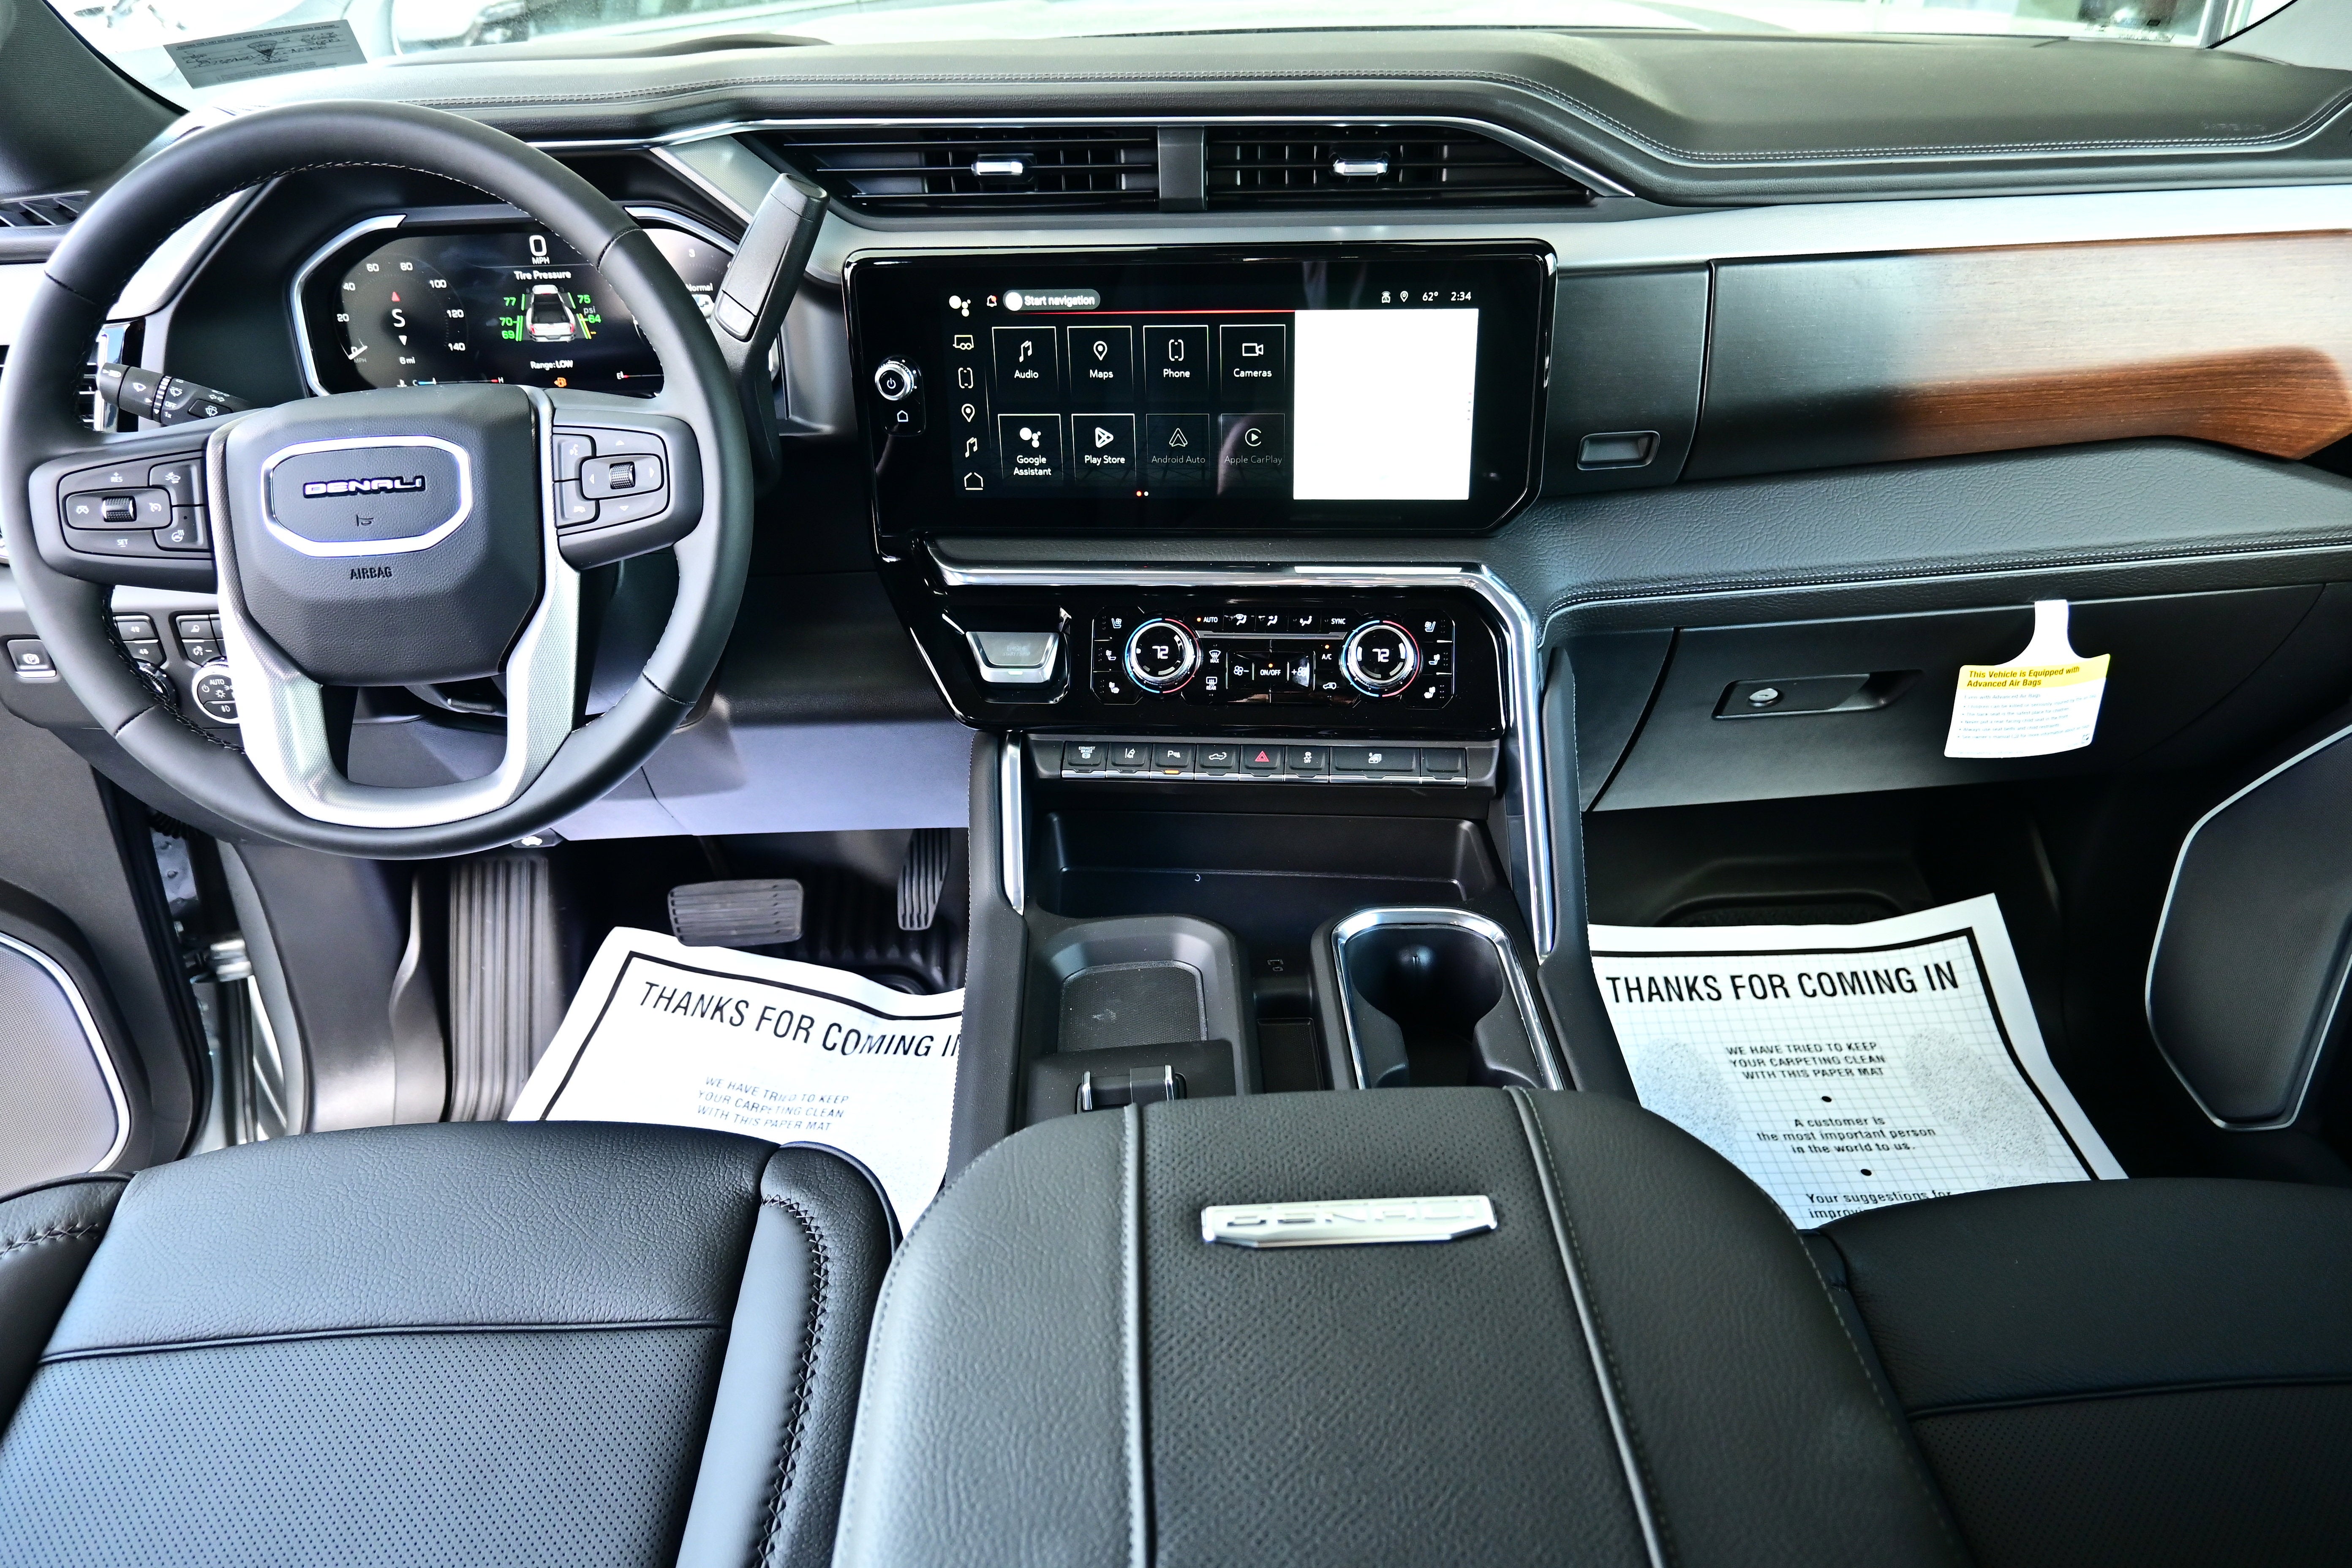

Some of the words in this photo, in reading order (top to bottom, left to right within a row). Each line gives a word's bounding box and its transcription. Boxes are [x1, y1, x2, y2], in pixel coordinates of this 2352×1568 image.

[529, 235, 547, 256] 0
[367, 264, 379, 272] 60
[400, 262, 413, 271] 80
[514, 271, 532, 280] Tire
[533, 270, 571, 280] Pressure
[343, 282, 356, 291] 40
[429, 280, 447, 288] 100
[685, 283, 713, 291] Normal
[504, 297, 516, 306] 77
[577, 295, 591, 304] 75
[1024, 295, 1047, 306] Start
[1048, 296, 1095, 307] navigation
[1451, 291, 1471, 301] 2:34
[446, 309, 464, 318] 120
[583, 306, 596, 315] psi
[337, 313, 349, 322] 20
[392, 309, 406, 327] S
[499, 317, 513, 326] 70
[588, 314, 602, 324] 64
[501, 330, 514, 339] 69
[448, 343, 466, 351] 140
[1014, 370, 1039, 379] Audio
[1089, 369, 1113, 380] Maps
[1163, 368, 1190, 378] Phone
[1233, 368, 1272, 378] Cameras
[1016, 455, 1047, 466] Google
[1085, 455, 1102, 466] Play
[1103, 455, 1125, 464] Store
[1152, 455, 1184, 463] Android
[1186, 455, 1206, 463] Auto
[1225, 455, 1248, 466] Apple
[1251, 455, 1282, 466] CarPlay
[1013, 467, 1052, 476] Assistant
[303, 475, 425, 498] DENALI
[350, 566, 392, 580] AIRBAG
[1152, 646, 1168, 659] 72
[1372, 649, 1389, 662] 72
[2028, 668, 2063, 678] Equipped
[2066, 666, 2080, 675] with
[2023, 678, 2041, 687] Bags
[1606, 975, 1722, 1003] THANKS
[1730, 974, 1791, 1000] FOR
[1797, 967, 1917, 998] COMING
[1924, 961, 1958, 991] IN
[639, 981, 750, 1027] THANKS
[755, 1005, 814, 1043] FOR
[822, 1023, 934, 1057] COMING
[1726, 1046, 1747, 1056] WE
[1750, 1044, 1783, 1055] HAVE
[1786, 1043, 1823, 1054] TRIED
[1827, 1043, 1843, 1052] TO
[1846, 1042, 1877, 1051] KEEP
[1729, 1058, 1766, 1068] YOUR
[1770, 1056, 1840, 1067] CARPETING
[1845, 1055, 1886, 1064] CLEAN
[1742, 1071, 1777, 1080] WITH
[1781, 1070, 1810, 1079] THIS
[1812, 1068, 1855, 1078] PAPER
[1858, 1067, 1884, 1077] MAT
[705, 1077, 724, 1088] WE
[727, 1081, 760, 1097] HAVE
[763, 1089, 797, 1103] TRIED
[801, 1094, 816, 1103] TO
[819, 1095, 849, 1104] KEEP
[698, 1089, 731, 1105] YOUR
[735, 1098, 802, 1116] CARPETING
[806, 1107, 845, 1118] CLEAN
[697, 1105, 730, 1120] WITH
[734, 1114, 761, 1127] THIS
[764, 1118, 803, 1130] PAPER
[806, 1122, 833, 1131] MAT
[1794, 1118, 1804, 1128] A
[1808, 1117, 1868, 1127] customer
[1874, 1116, 1885, 1125] is
[1757, 1132, 1778, 1141] the
[1783, 1131, 1816, 1141] most
[1820, 1129, 1886, 1141] important
[1890, 1127, 1936, 1139] person
[1791, 1144, 1805, 1154] in
[1809, 1144, 1830, 1154] the
[1834, 1142, 1873, 1153] world
[1876, 1142, 1890, 1152] to
[1894, 1142, 1916, 1151] us.
[1806, 1193, 1839, 1204] Your
[1844, 1191, 1929, 1204] suggestions
